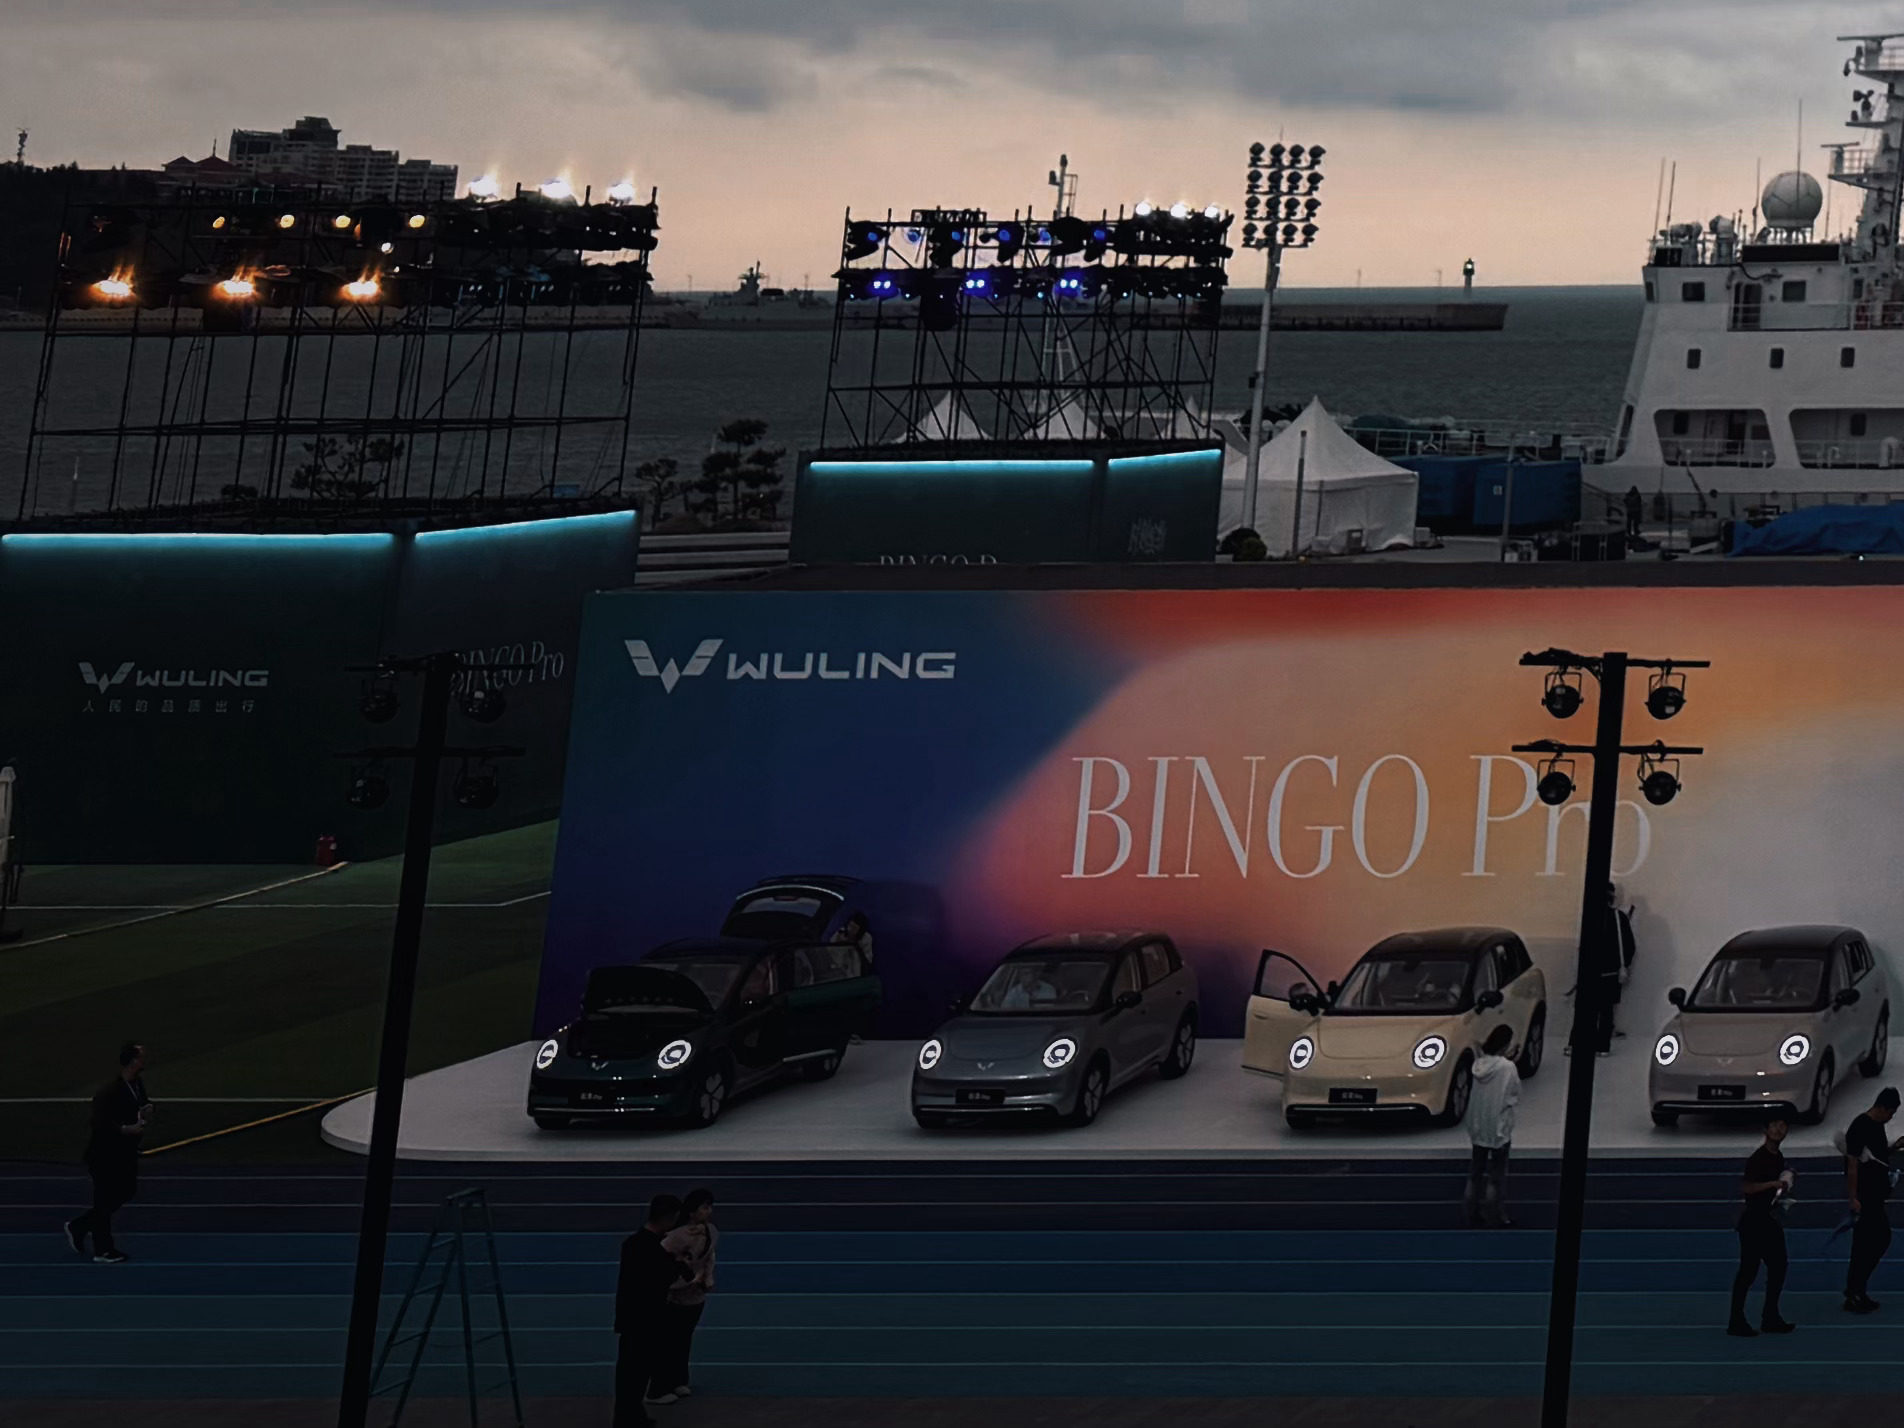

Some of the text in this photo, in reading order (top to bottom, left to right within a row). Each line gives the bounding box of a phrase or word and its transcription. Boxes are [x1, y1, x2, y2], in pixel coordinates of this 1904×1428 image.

[135, 669, 270, 687] WULING
[527, 640, 565, 684] Pro
[727, 652, 956, 679] WULING
[1061, 754, 1652, 879] BINGO Pro
